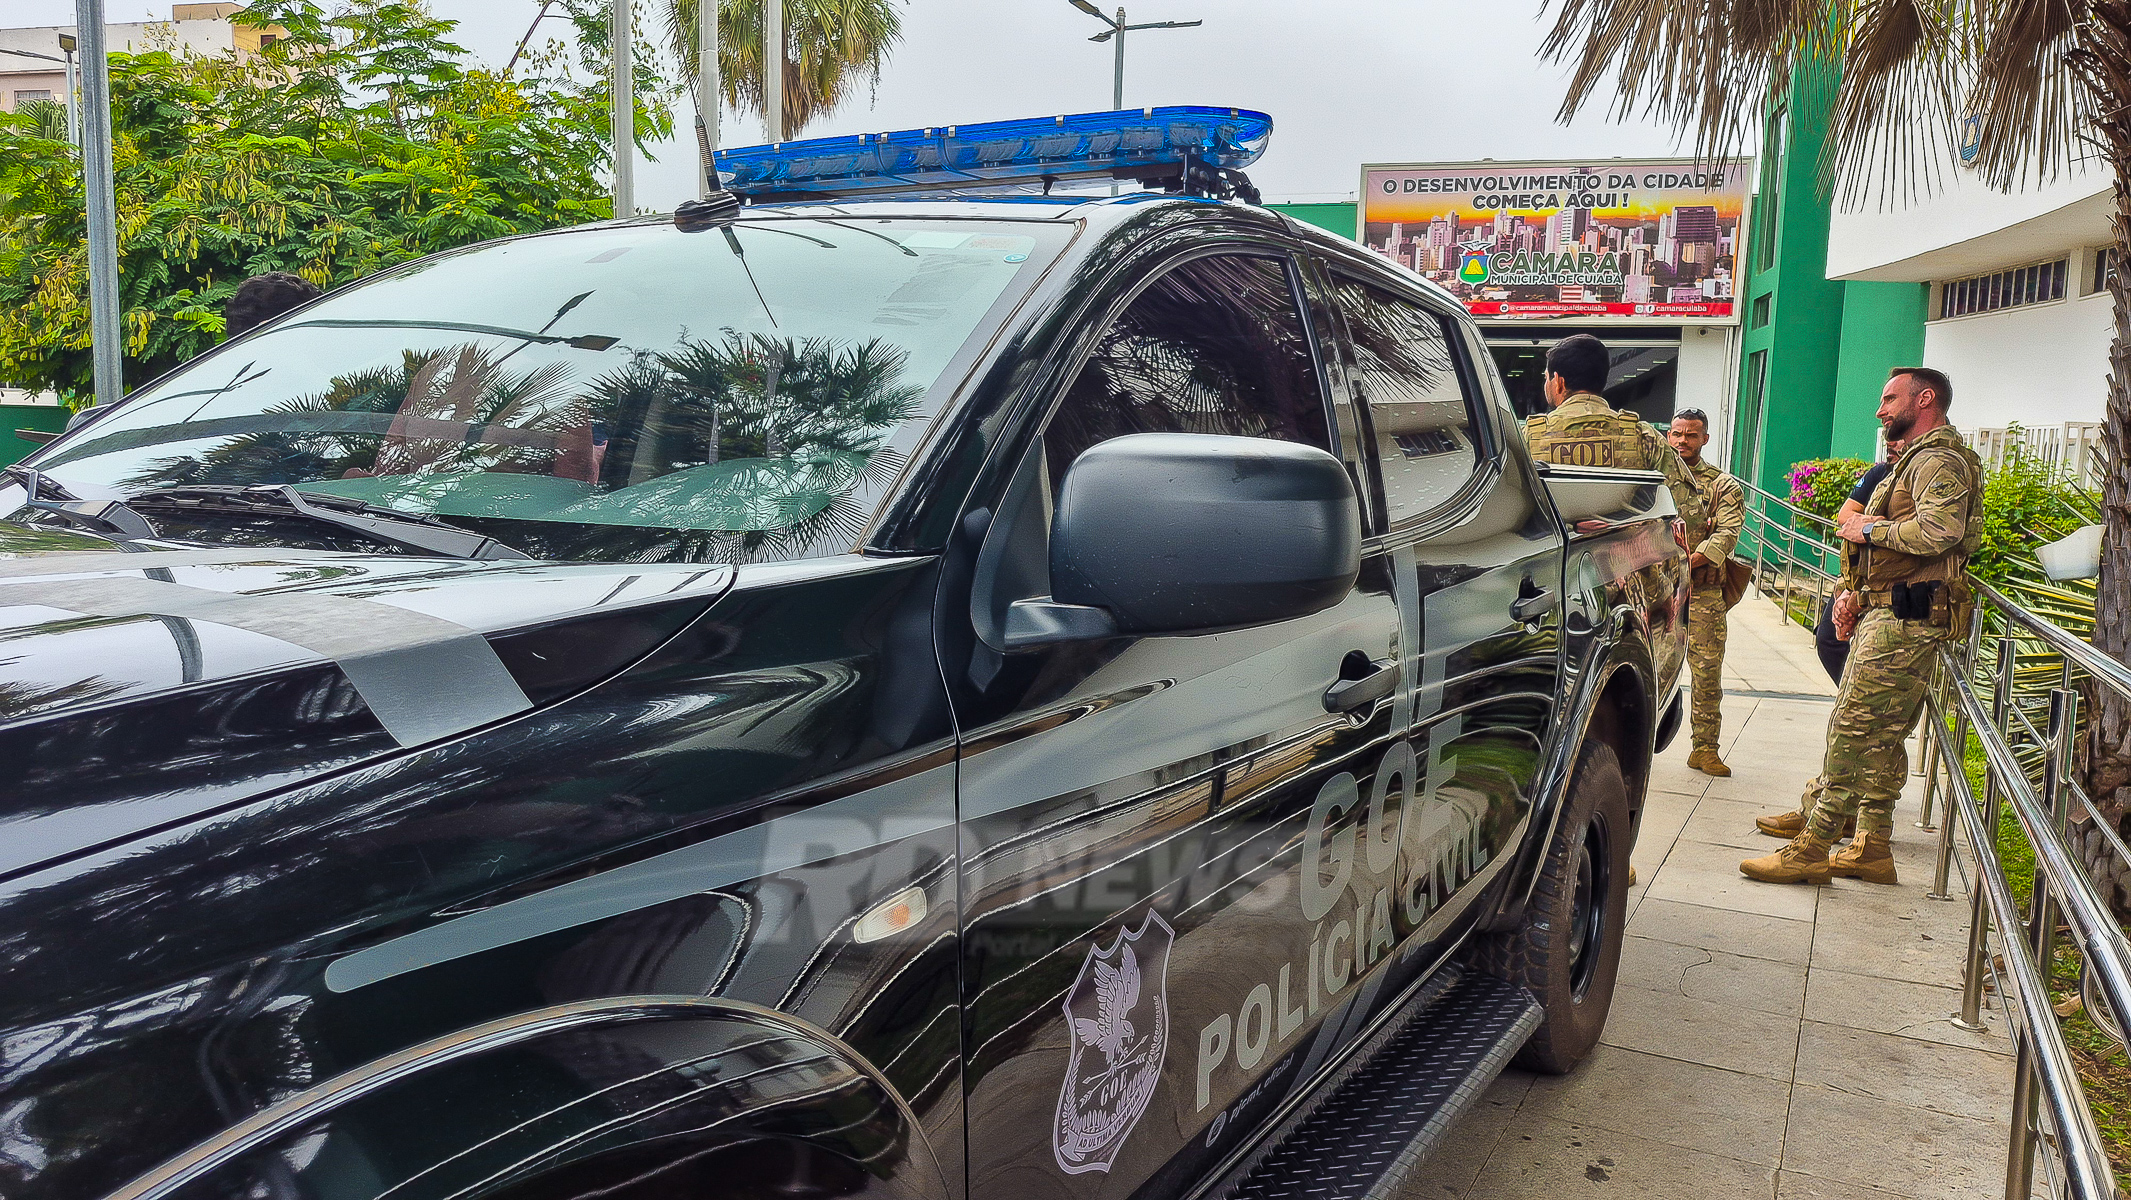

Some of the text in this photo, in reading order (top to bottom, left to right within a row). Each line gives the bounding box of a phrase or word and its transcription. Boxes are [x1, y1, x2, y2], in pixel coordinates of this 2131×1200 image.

[1383, 173, 1724, 194] O DESENVOLVIMENTO DA CIDADE
[1472, 193, 1560, 211] COMEÇA
[1564, 193, 1617, 208] AQUI
[1491, 249, 1620, 274] CÂMARA
[1491, 274, 1555, 284] MUNICIPAL
[1557, 274, 1574, 284] DE
[1656, 304, 1708, 313] camaracuiaba
[1552, 442, 1612, 466] GOE
[1300, 713, 1462, 921] GOE
[1197, 819, 1488, 1113] POLÍCIA CIVIL
[1100, 1068, 1128, 1107] GOE
